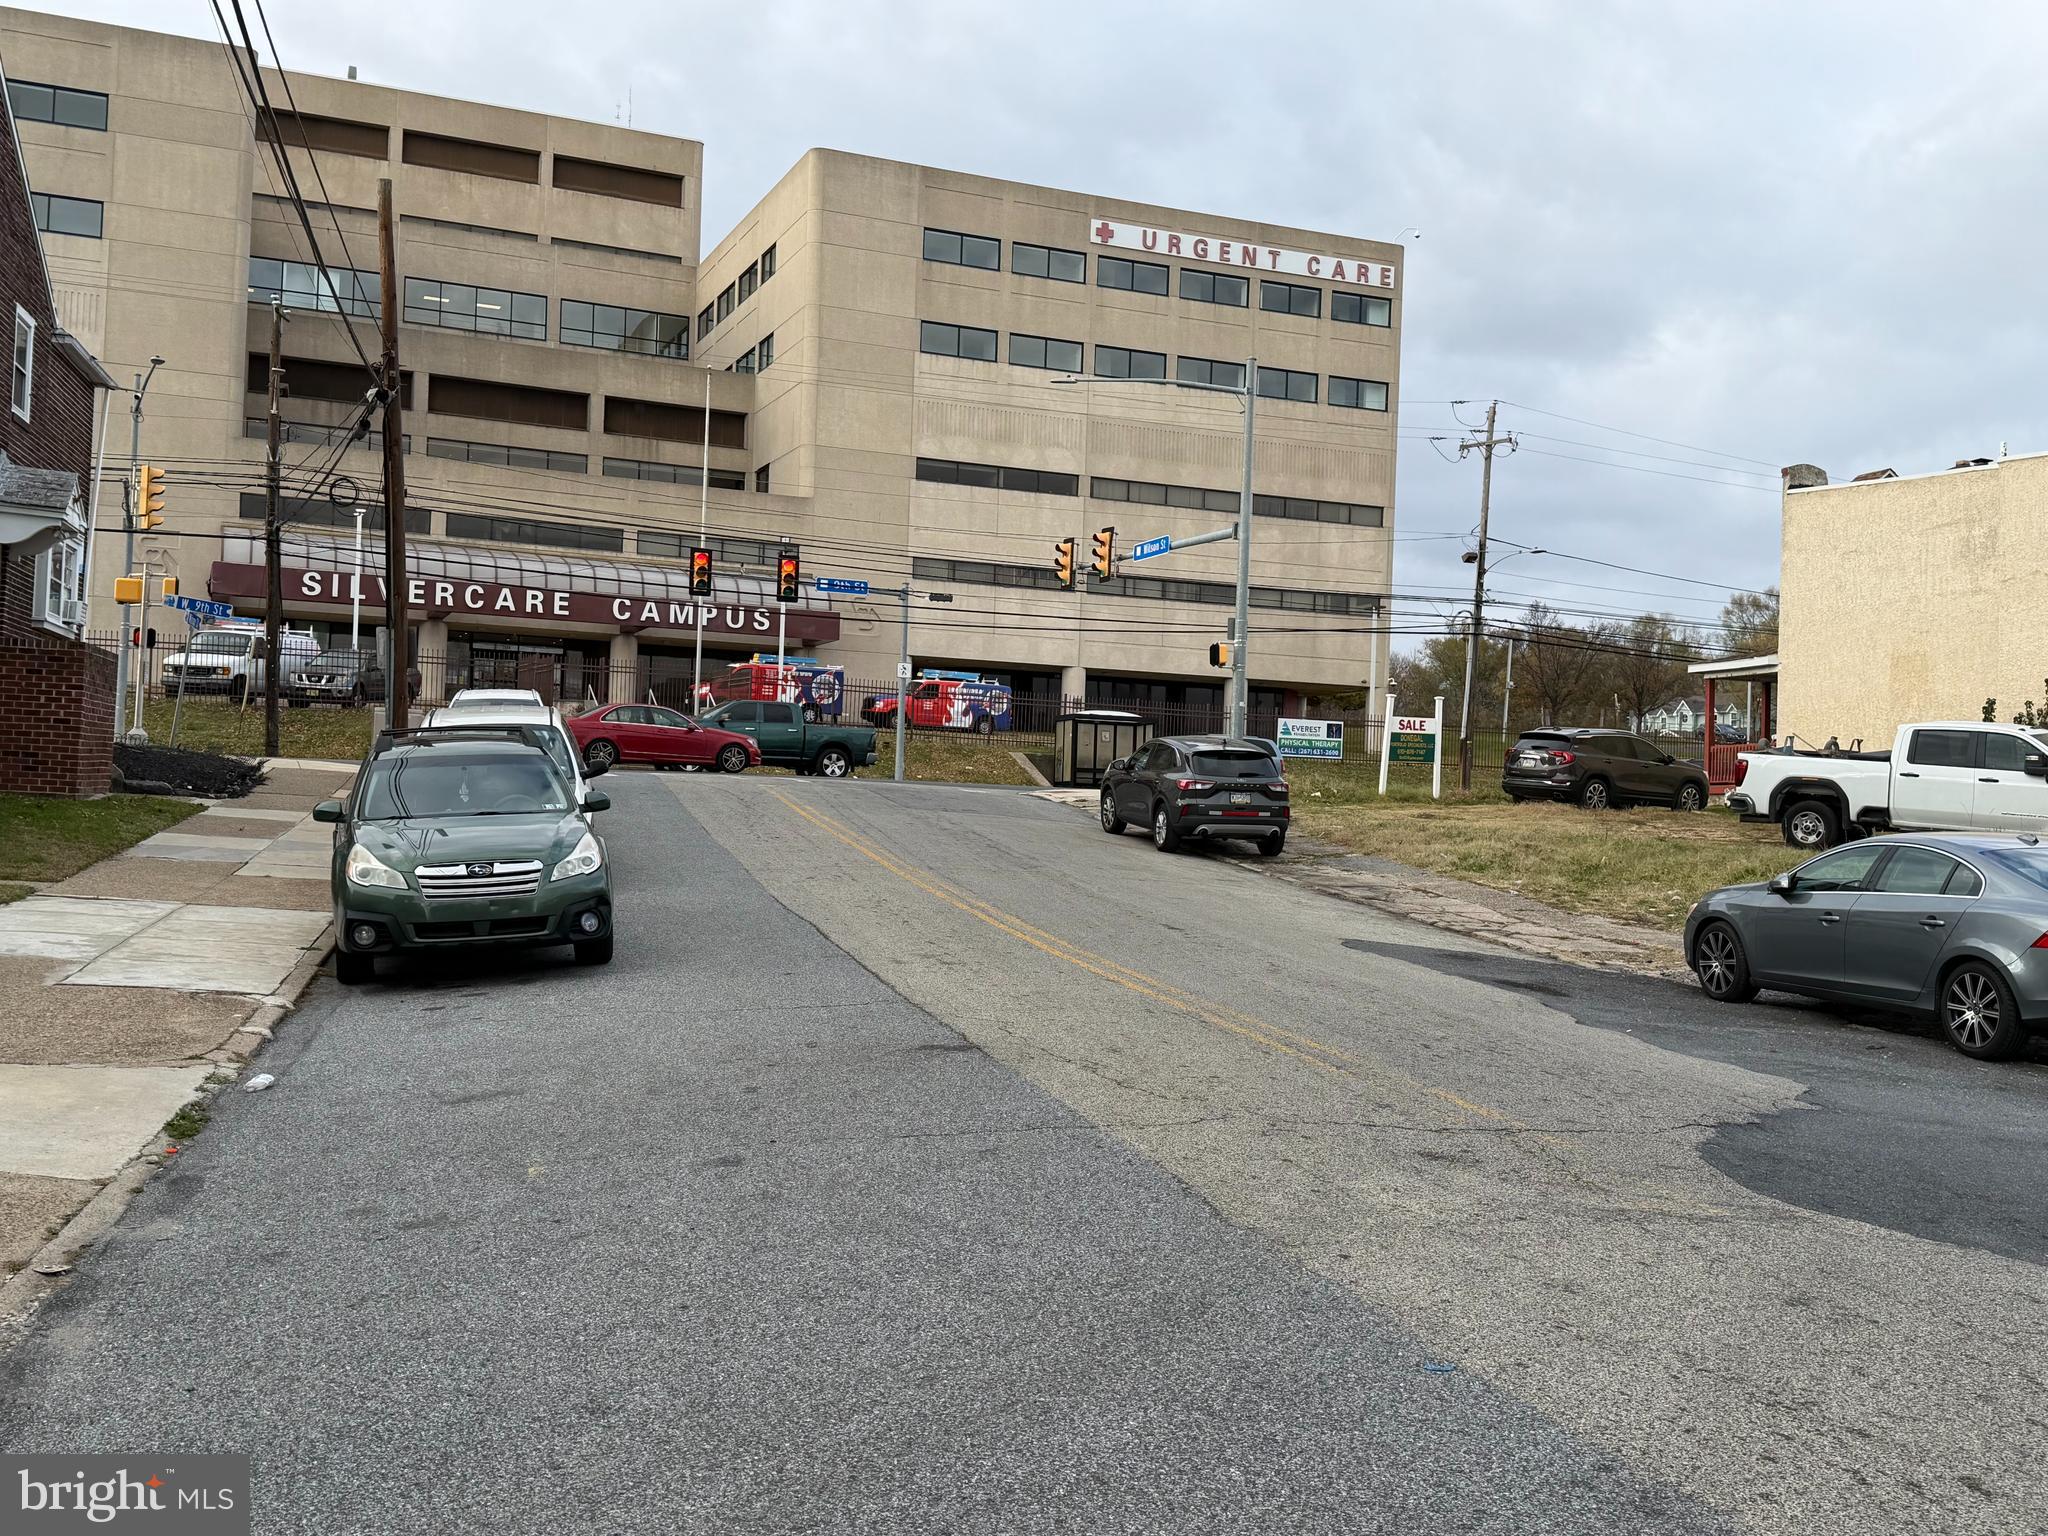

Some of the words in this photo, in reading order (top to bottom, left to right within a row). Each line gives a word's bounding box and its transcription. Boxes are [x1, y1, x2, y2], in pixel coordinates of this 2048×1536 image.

[1142, 228, 1281, 270] URGENT
[1307, 256, 1392, 287] CARE
[1143, 543, 1159, 555] Wilson
[1160, 539, 1166, 550] St
[181, 598, 188, 608] W
[195, 601, 209, 613] 9th
[213, 604, 223, 616] St
[612, 598, 770, 631] CAMPUS
[1291, 725, 1322, 733] EVEREST
[1399, 719, 1426, 731] SALE
[1280, 739, 1310, 747] PHYSICAL
[1312, 740, 1339, 748] THERAPY
